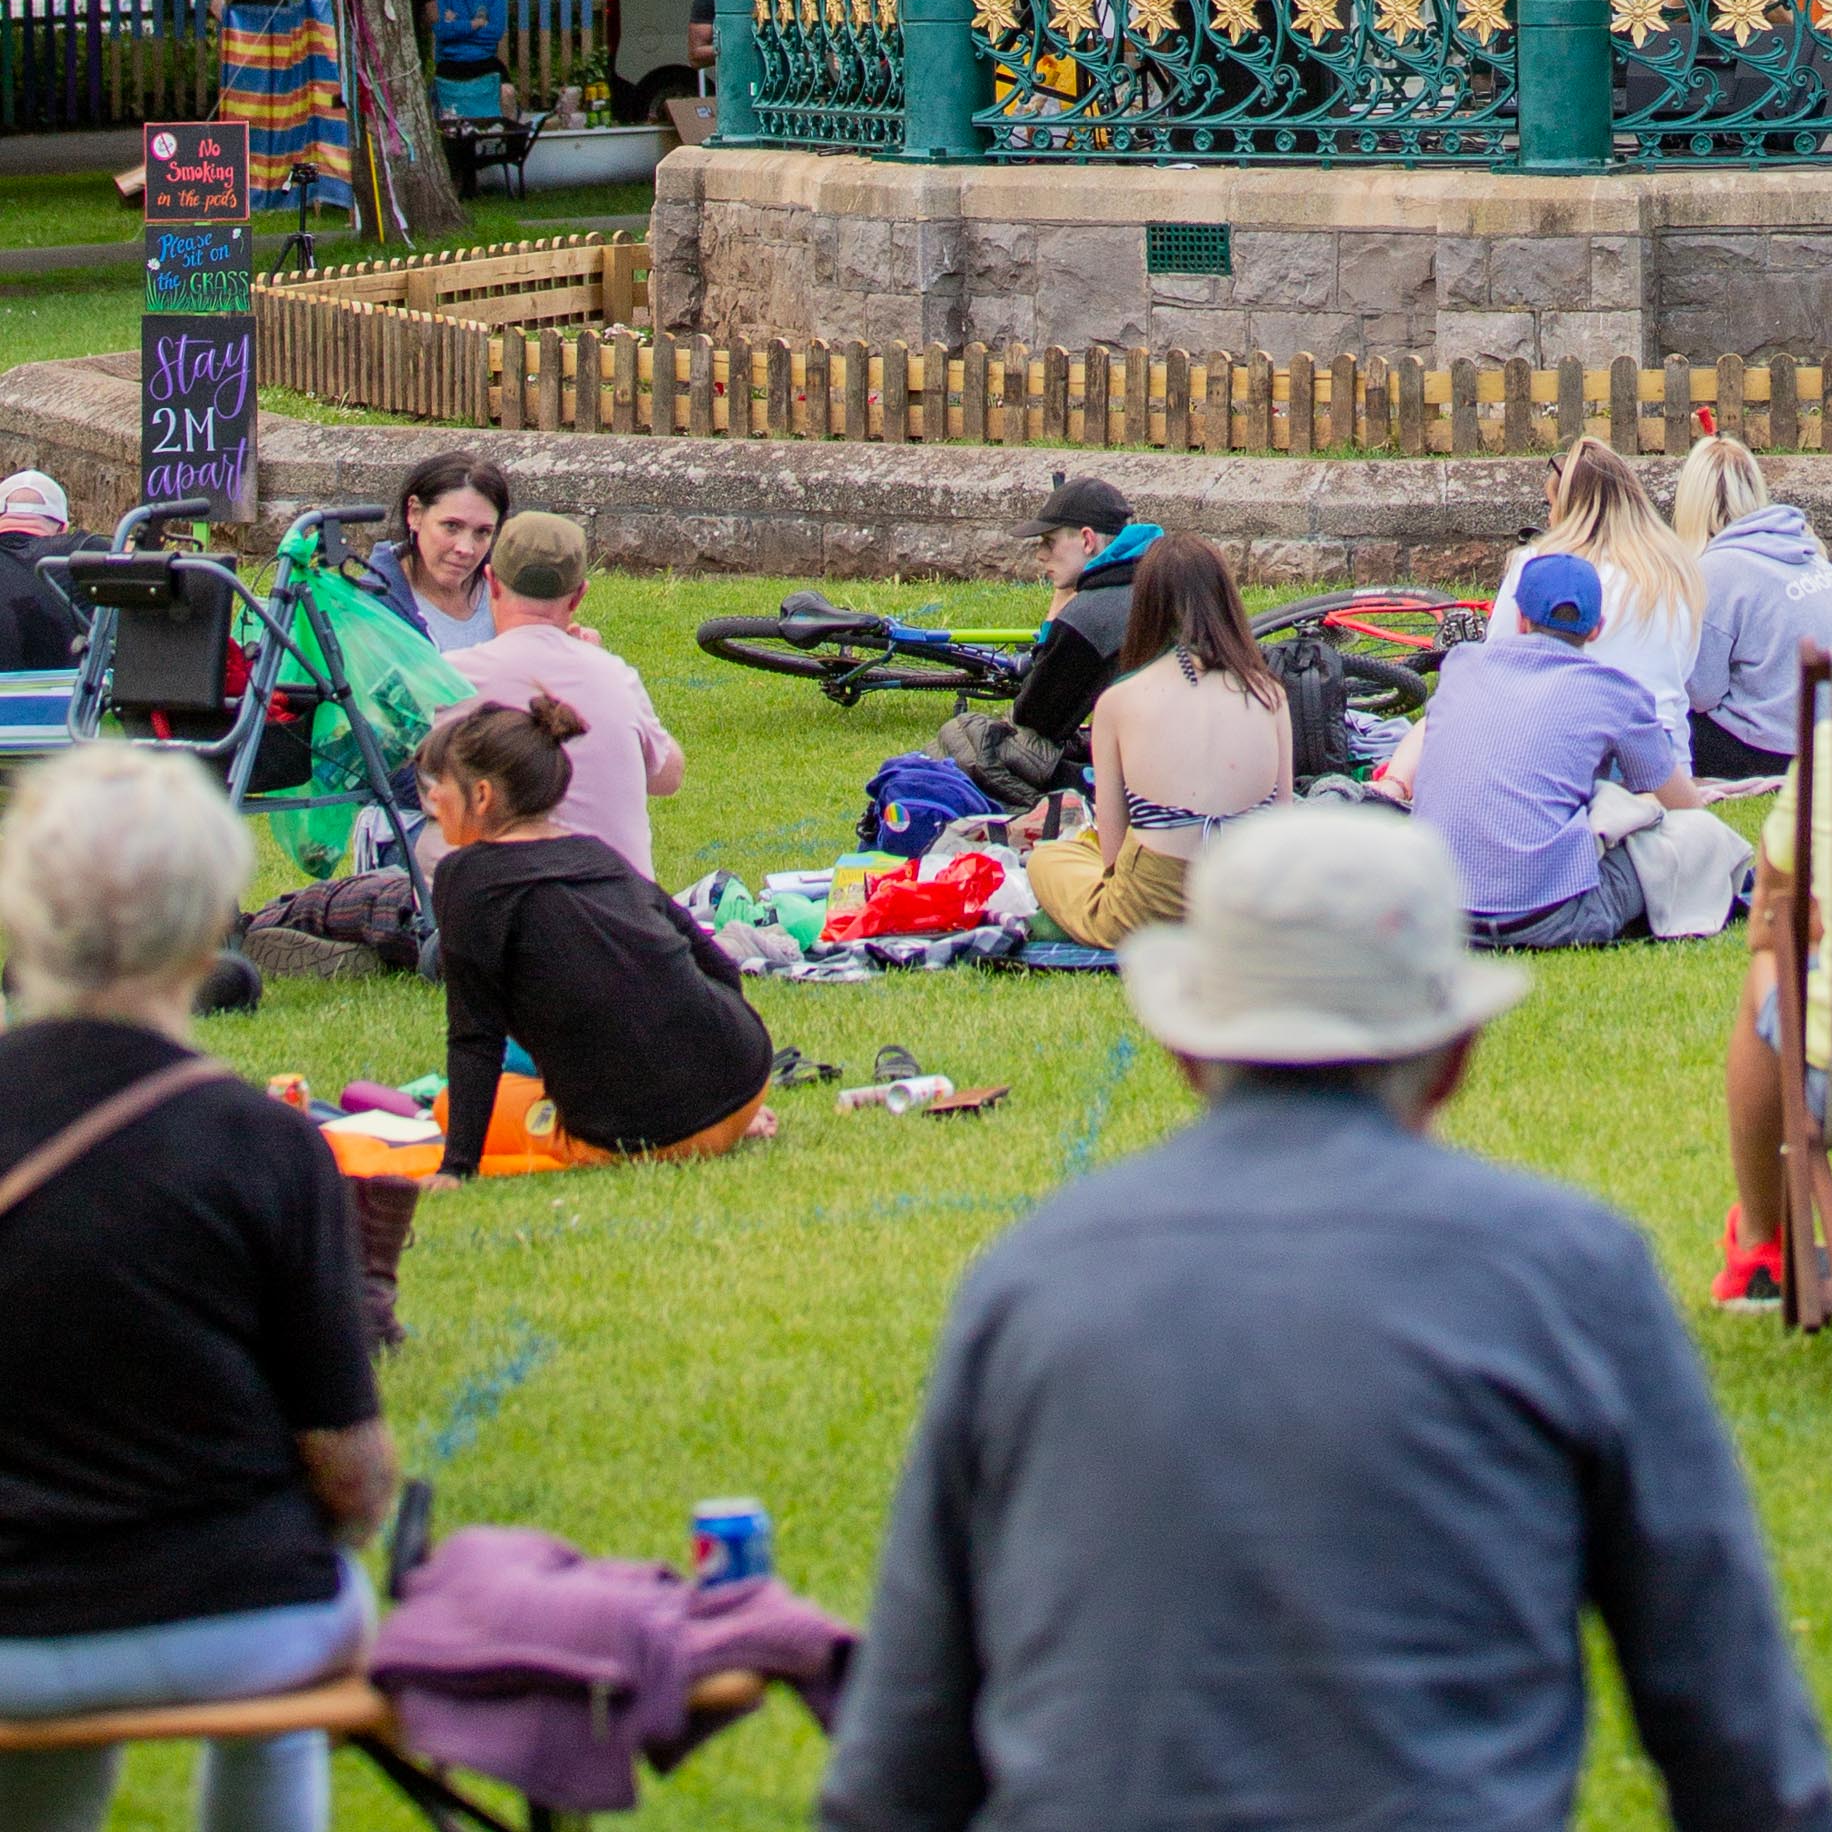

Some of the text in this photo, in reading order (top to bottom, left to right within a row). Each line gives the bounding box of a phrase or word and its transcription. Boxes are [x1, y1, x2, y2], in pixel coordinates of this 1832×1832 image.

[198, 138, 221, 158] No
[165, 160, 234, 189] Smoking
[157, 188, 238, 213] in the pods
[156, 233, 213, 263] Please
[182, 244, 230, 268] sit on
[157, 270, 249, 295] the GRASS
[152, 407, 217, 453] 2M
[147, 437, 254, 503] apart
